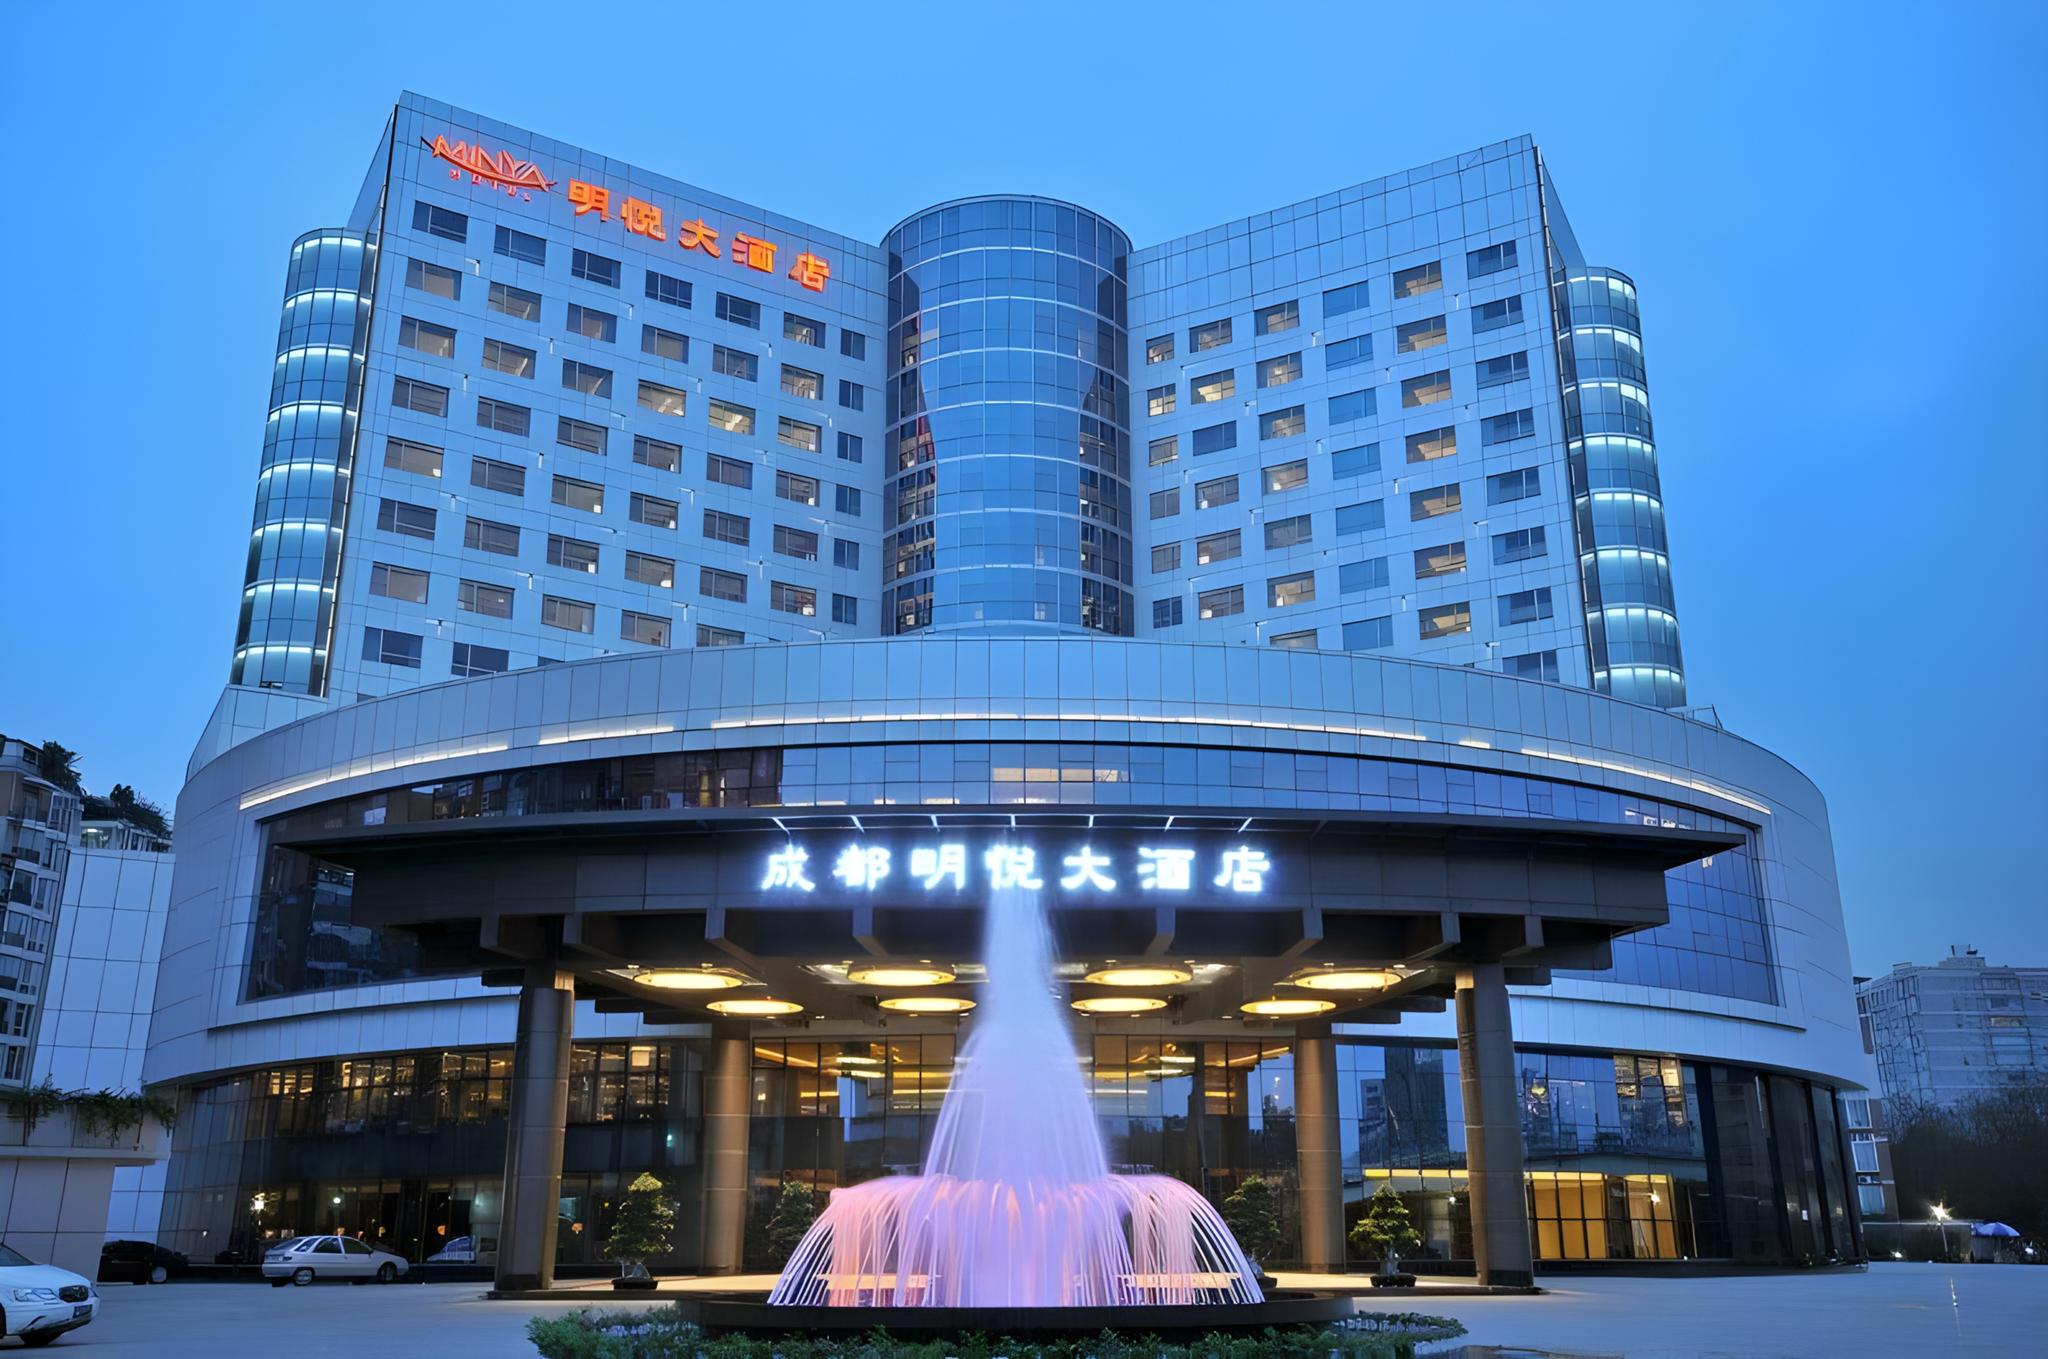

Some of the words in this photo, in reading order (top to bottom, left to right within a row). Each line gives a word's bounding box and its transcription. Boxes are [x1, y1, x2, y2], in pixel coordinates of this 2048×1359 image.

[568, 178, 831, 292] 明悦大酒店
[761, 843, 1271, 893] 成都明悦大酒店
